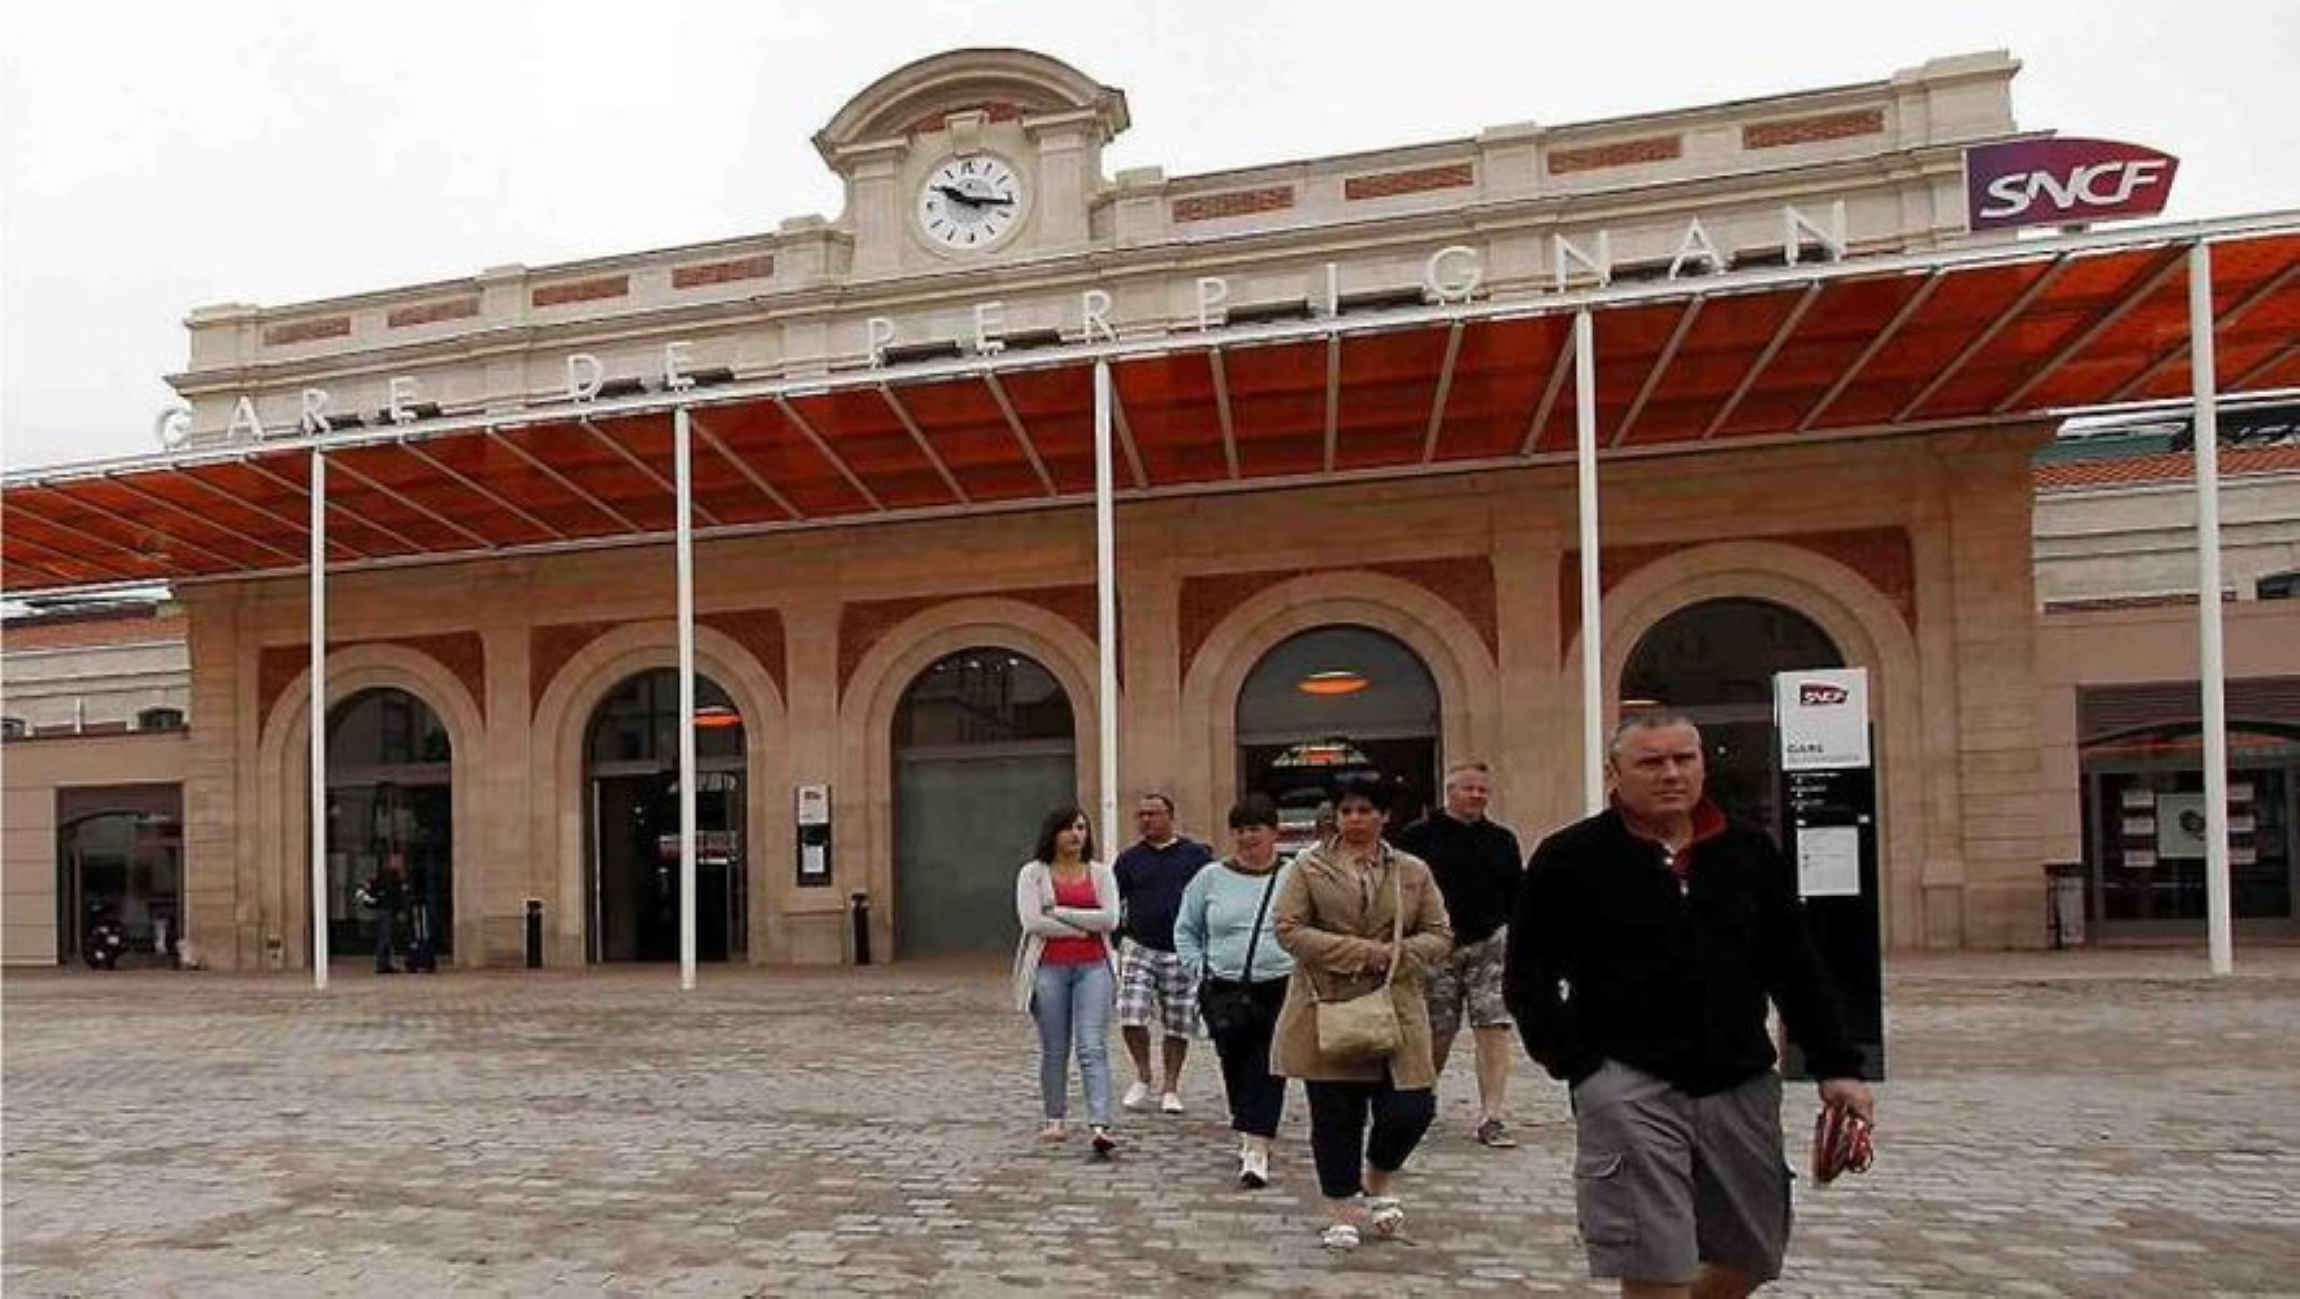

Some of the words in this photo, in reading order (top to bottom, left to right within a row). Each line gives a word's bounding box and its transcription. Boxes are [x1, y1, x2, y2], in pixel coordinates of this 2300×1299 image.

[1979, 158, 2168, 218] SNCF
[154, 376, 424, 448] GARE
[564, 341, 695, 403] DE
[866, 200, 1847, 368] PERPIGNAN
